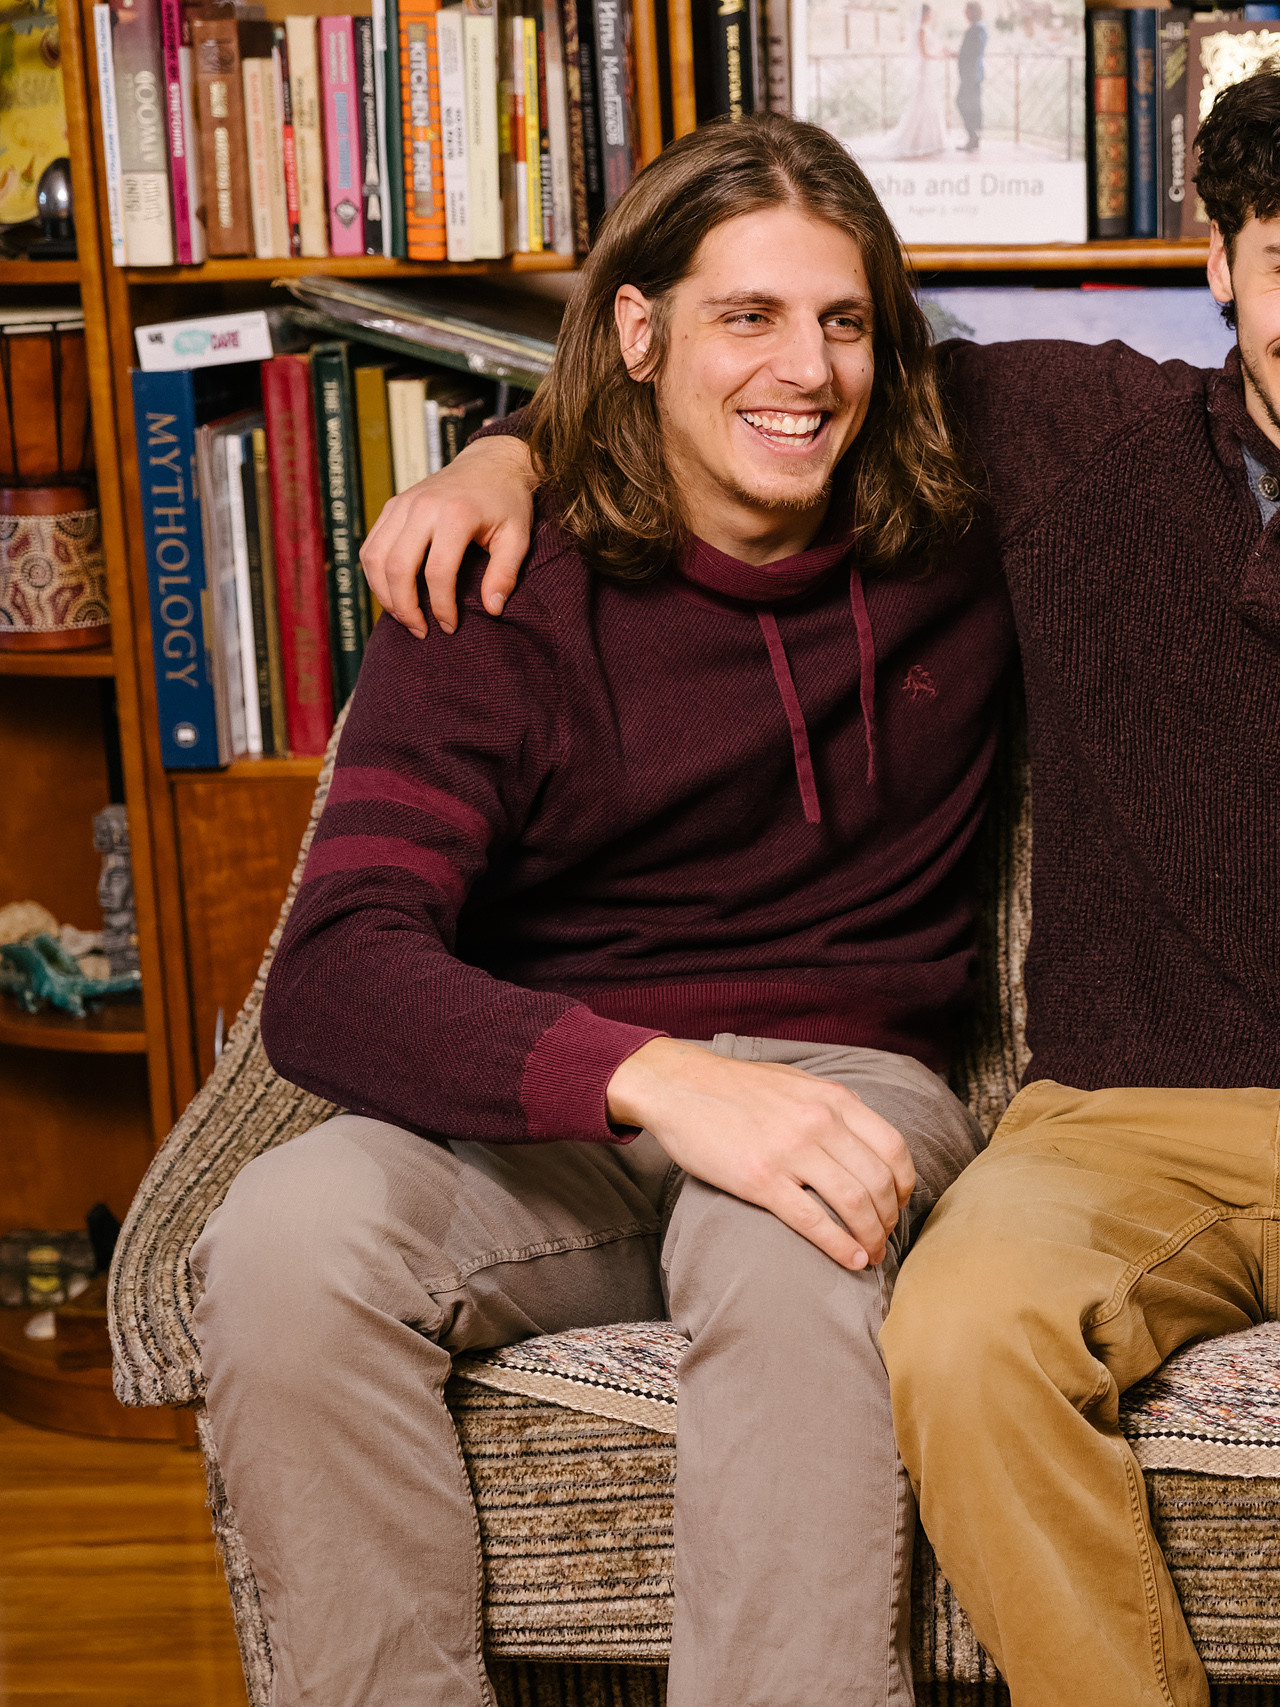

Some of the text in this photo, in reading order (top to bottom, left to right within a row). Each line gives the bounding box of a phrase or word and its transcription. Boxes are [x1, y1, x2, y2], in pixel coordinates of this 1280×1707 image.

[599, 1, 614, 49] Игры
[133, 70, 157, 162] ATWOOD
[409, 41, 429, 127] KITCHEN
[876, 173, 1044, 196] sha and Dima
[145, 411, 199, 688] MYTHOLOGY
[323, 379, 357, 652] THE WONDERS OF LIFE ON EARTH
[294, 624, 320, 704] ATLAS
